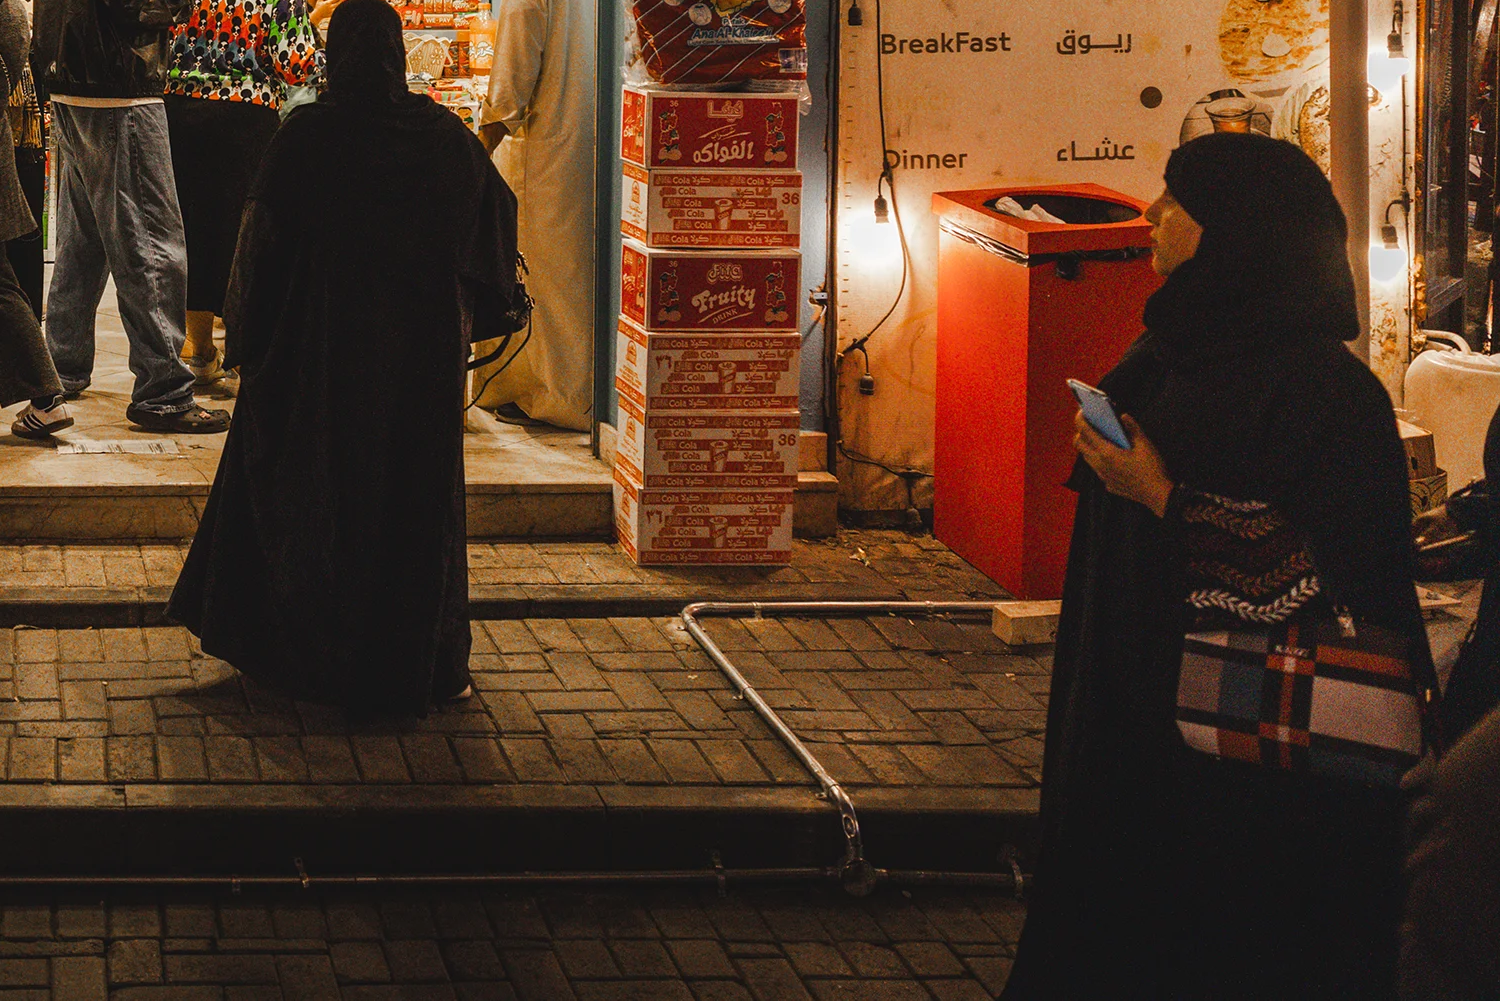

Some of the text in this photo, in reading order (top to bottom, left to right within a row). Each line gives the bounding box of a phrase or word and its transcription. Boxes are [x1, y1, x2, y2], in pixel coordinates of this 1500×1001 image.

[881, 32, 1011, 55] BreakFast
[1056, 30, 1132, 55] ريوق
[884, 149, 968, 170] Dinner
[1056, 137, 1135, 162] عشاء
[781, 192, 800, 205] 36
[691, 284, 757, 314] Fruity
[712, 308, 739, 325] DRINK
[778, 434, 797, 446] 36
